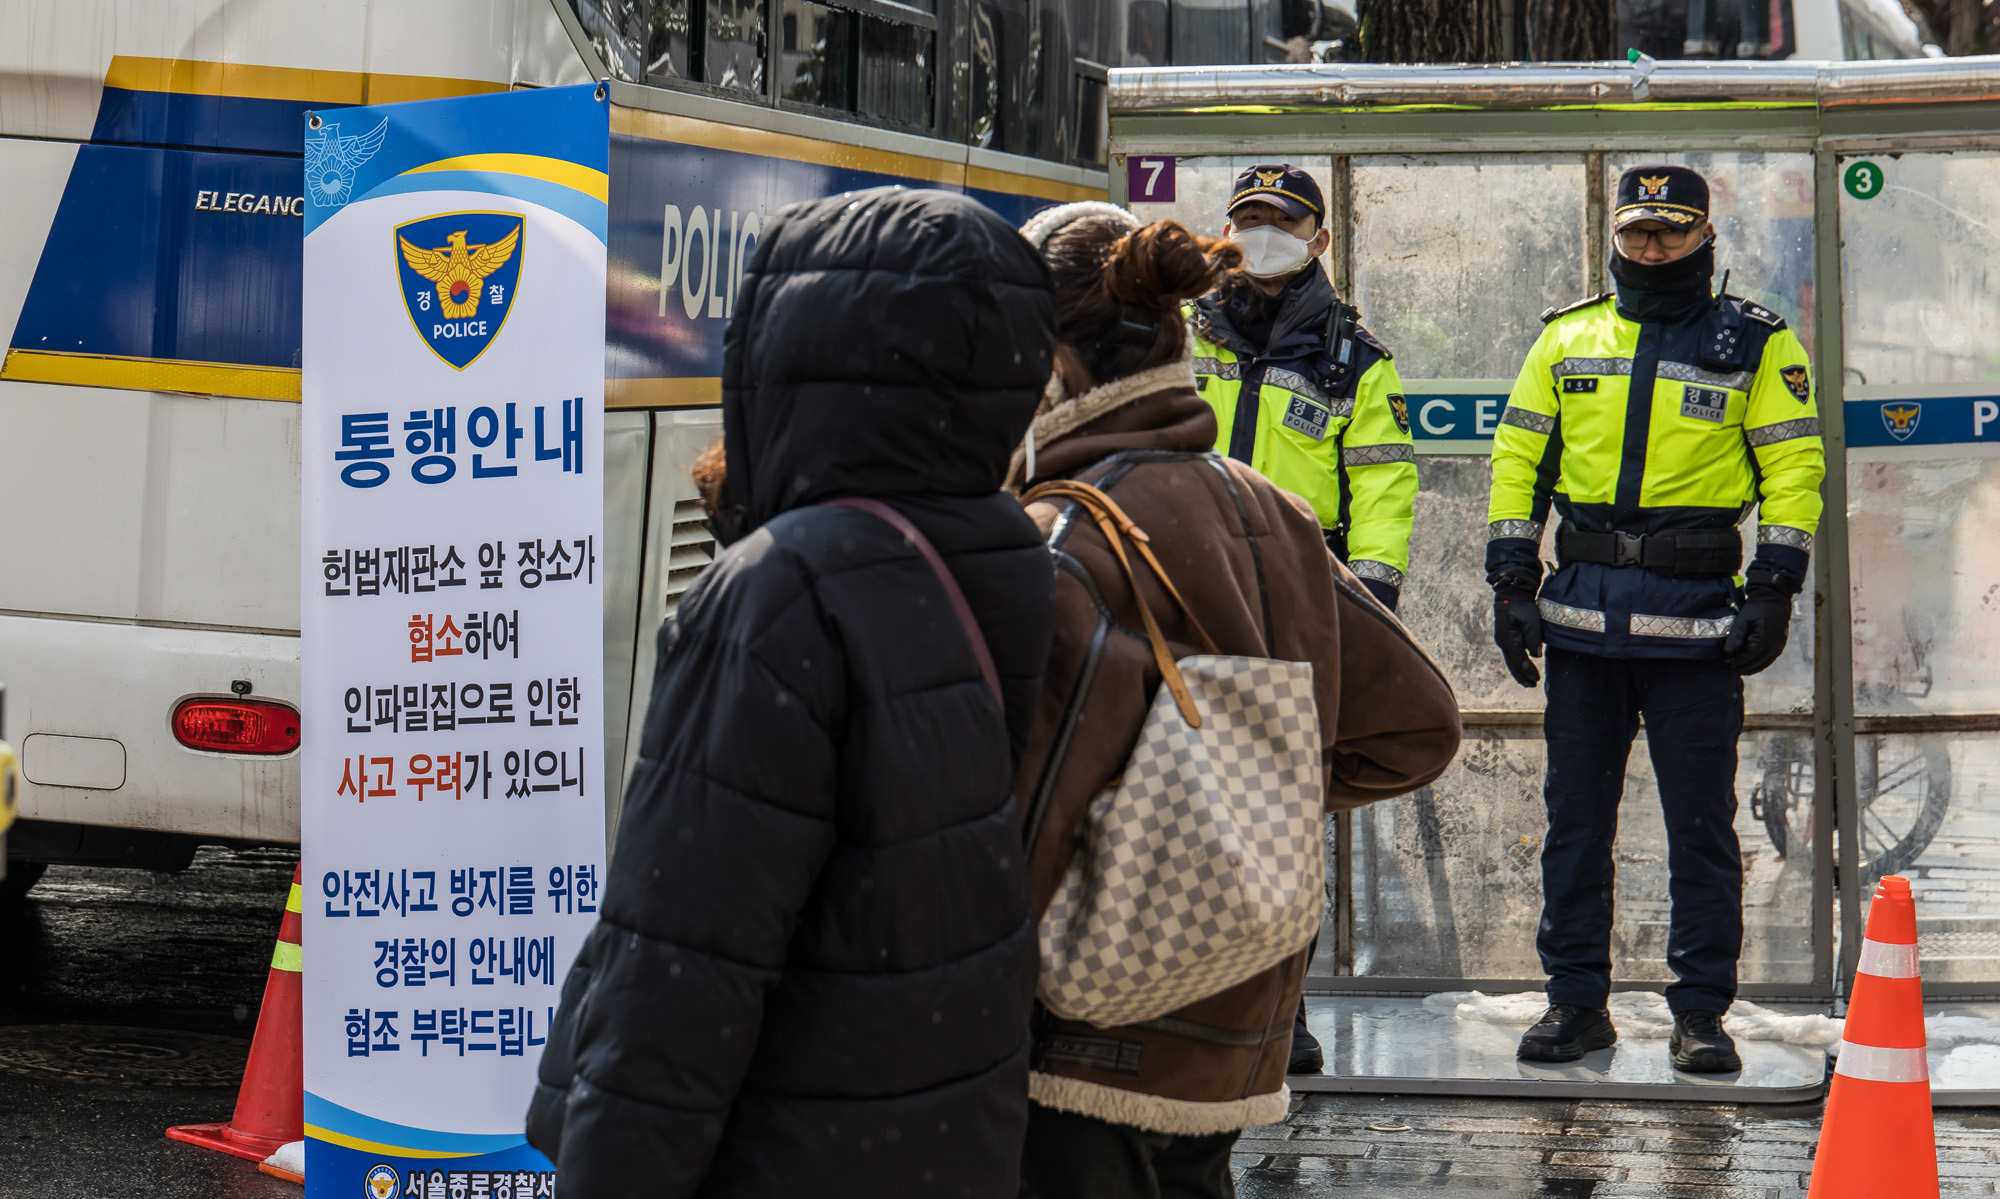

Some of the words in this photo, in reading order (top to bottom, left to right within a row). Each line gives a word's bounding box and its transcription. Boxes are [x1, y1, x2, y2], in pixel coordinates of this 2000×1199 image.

[1140, 160, 1165, 196] 7
[1855, 167, 1873, 194] 3
[416, 290, 431, 312] 경
[488, 284, 505, 305] 찰
[433, 320, 487, 340] POLICE
[1286, 415, 1323, 437] POLICE
[1684, 405, 1722, 420] POLICE
[334, 397, 584, 489] 통행안내
[321, 544, 467, 597] 헌법재판소
[477, 540, 506, 590] 앞
[517, 535, 596, 589] 장소가
[407, 609, 519, 663] 협소하여
[344, 682, 516, 734] 인파밀집으로
[527, 676, 581, 727] 인한
[336, 754, 397, 803] 사고
[406, 750, 493, 801] 우려가
[503, 747, 585, 800] 있으니
[322, 869, 439, 918] 안전사고
[449, 866, 536, 917] 방지를
[547, 864, 599, 915] 위한
[373, 937, 456, 989] 경찰의
[469, 935, 555, 986] 안내에
[344, 1007, 401, 1058] 협조
[405, 1171, 557, 1199] 서울종로경찰서
